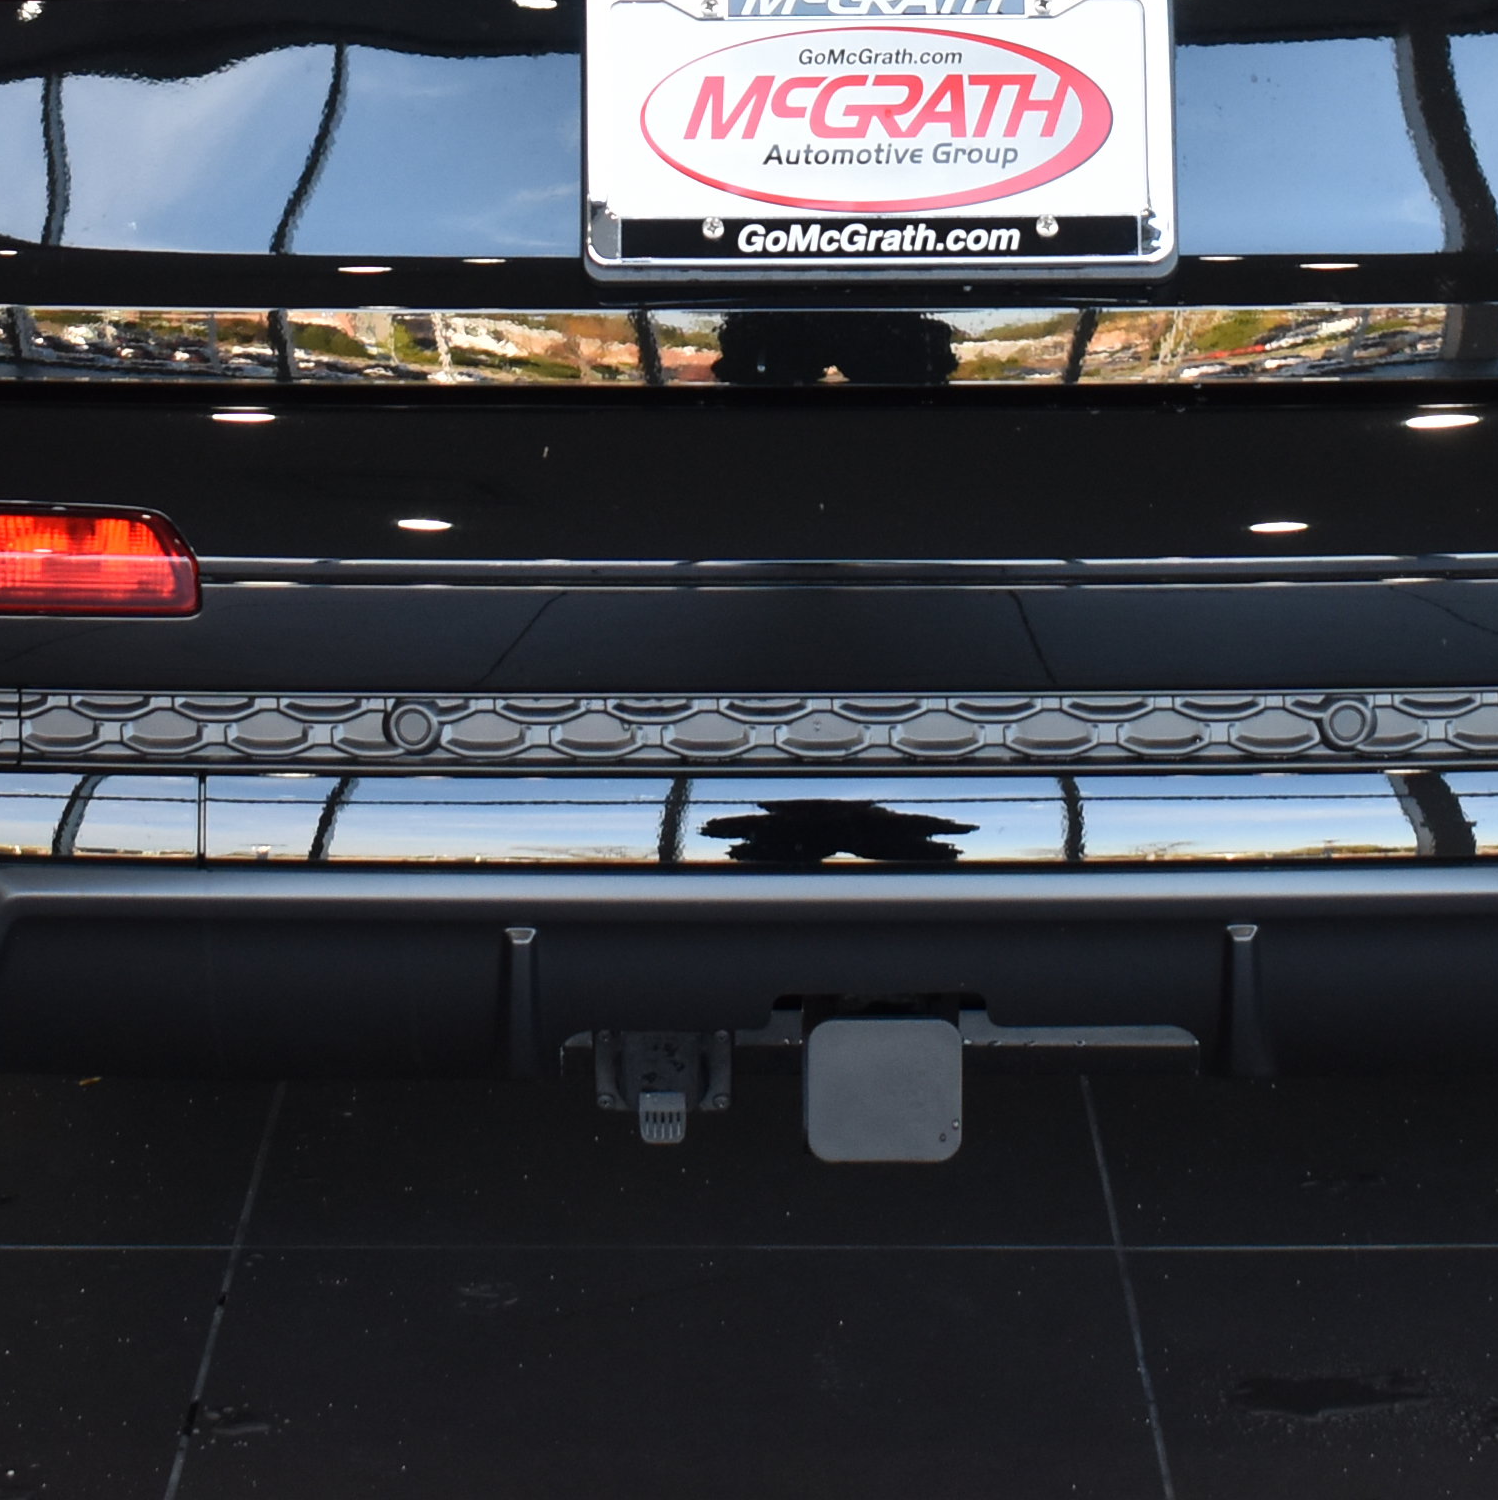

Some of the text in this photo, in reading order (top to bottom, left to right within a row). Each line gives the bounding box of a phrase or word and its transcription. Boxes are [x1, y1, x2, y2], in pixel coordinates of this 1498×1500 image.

[798, 48, 963, 66] GoMcGrath.com
[763, 143, 1019, 169] Automotive Group
[737, 224, 1020, 253] GoMcGrath.com
